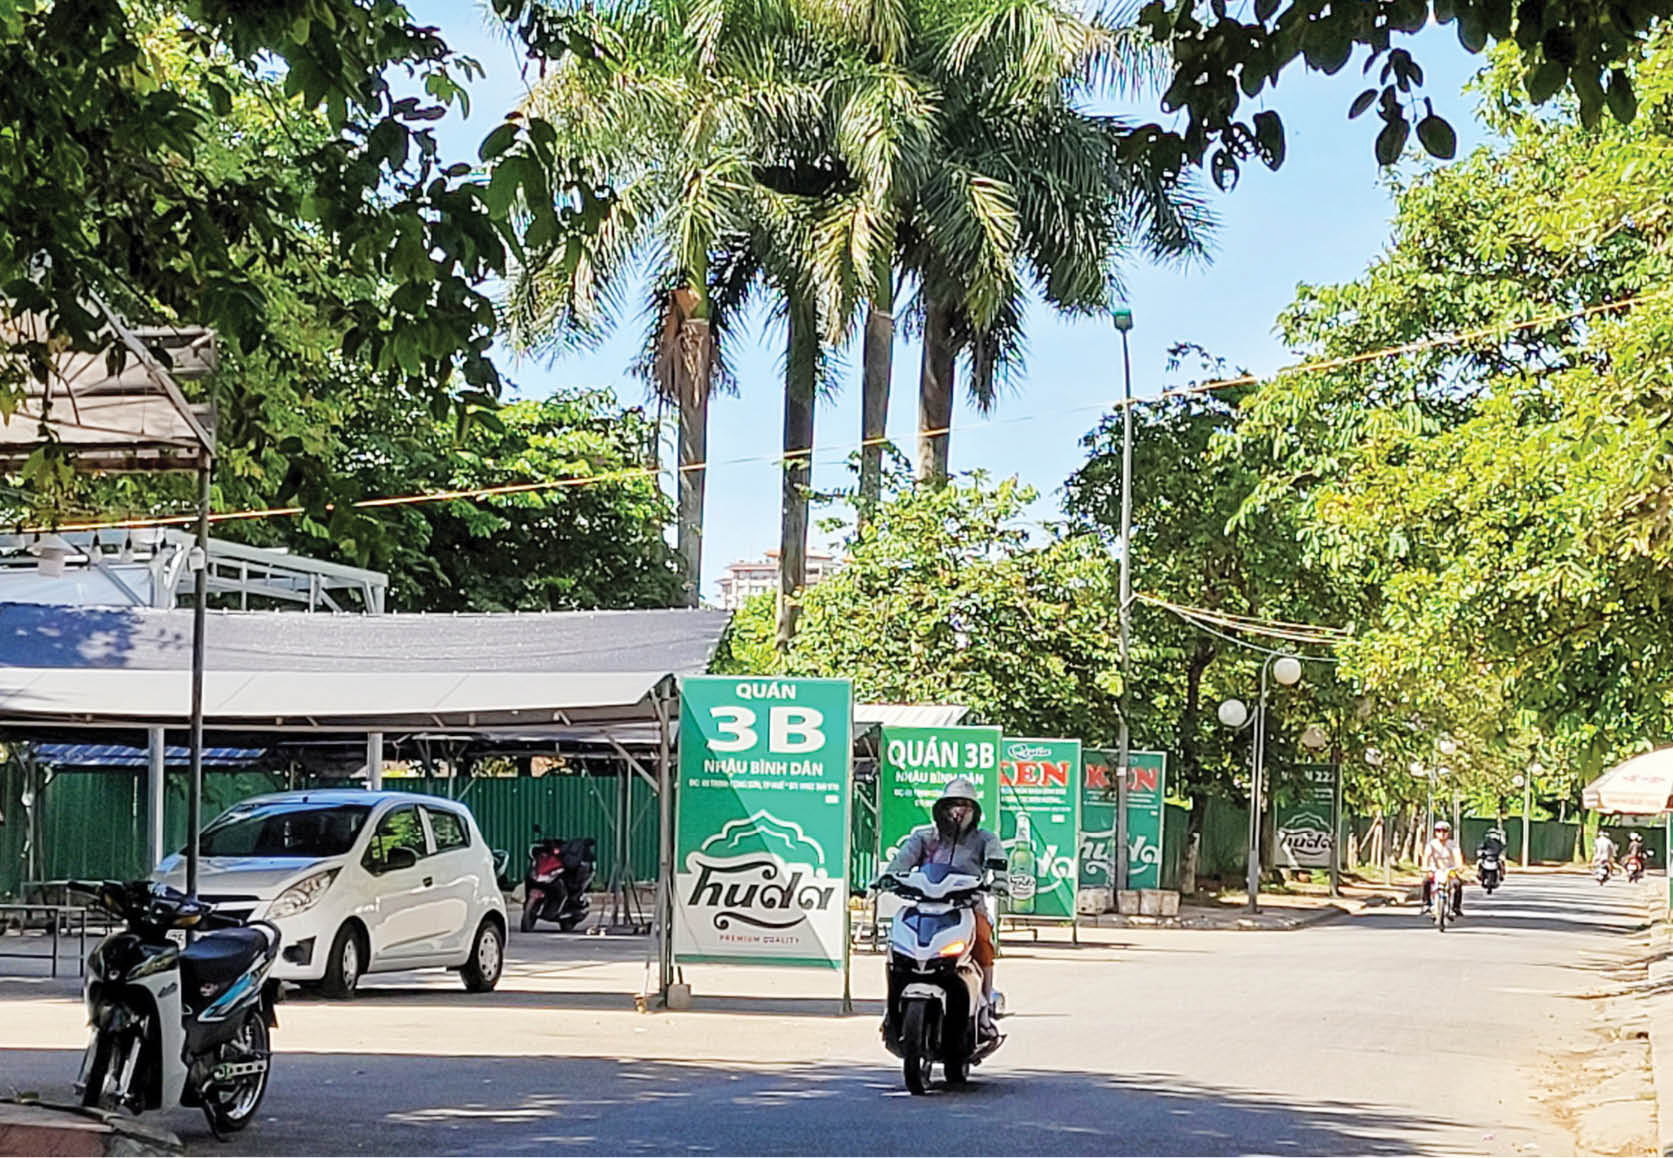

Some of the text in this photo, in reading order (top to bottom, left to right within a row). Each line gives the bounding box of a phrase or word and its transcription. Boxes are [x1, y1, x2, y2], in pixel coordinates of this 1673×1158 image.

[735, 681, 797, 700] QUÁN
[887, 736, 995, 770] QUÁN 3B
[704, 758, 823, 778] NHẬU BÌNH DÂN
[1085, 763, 1159, 791] KN
[688, 860, 835, 911] huda
[720, 934, 800, 945] PREMIUM QUALITY
